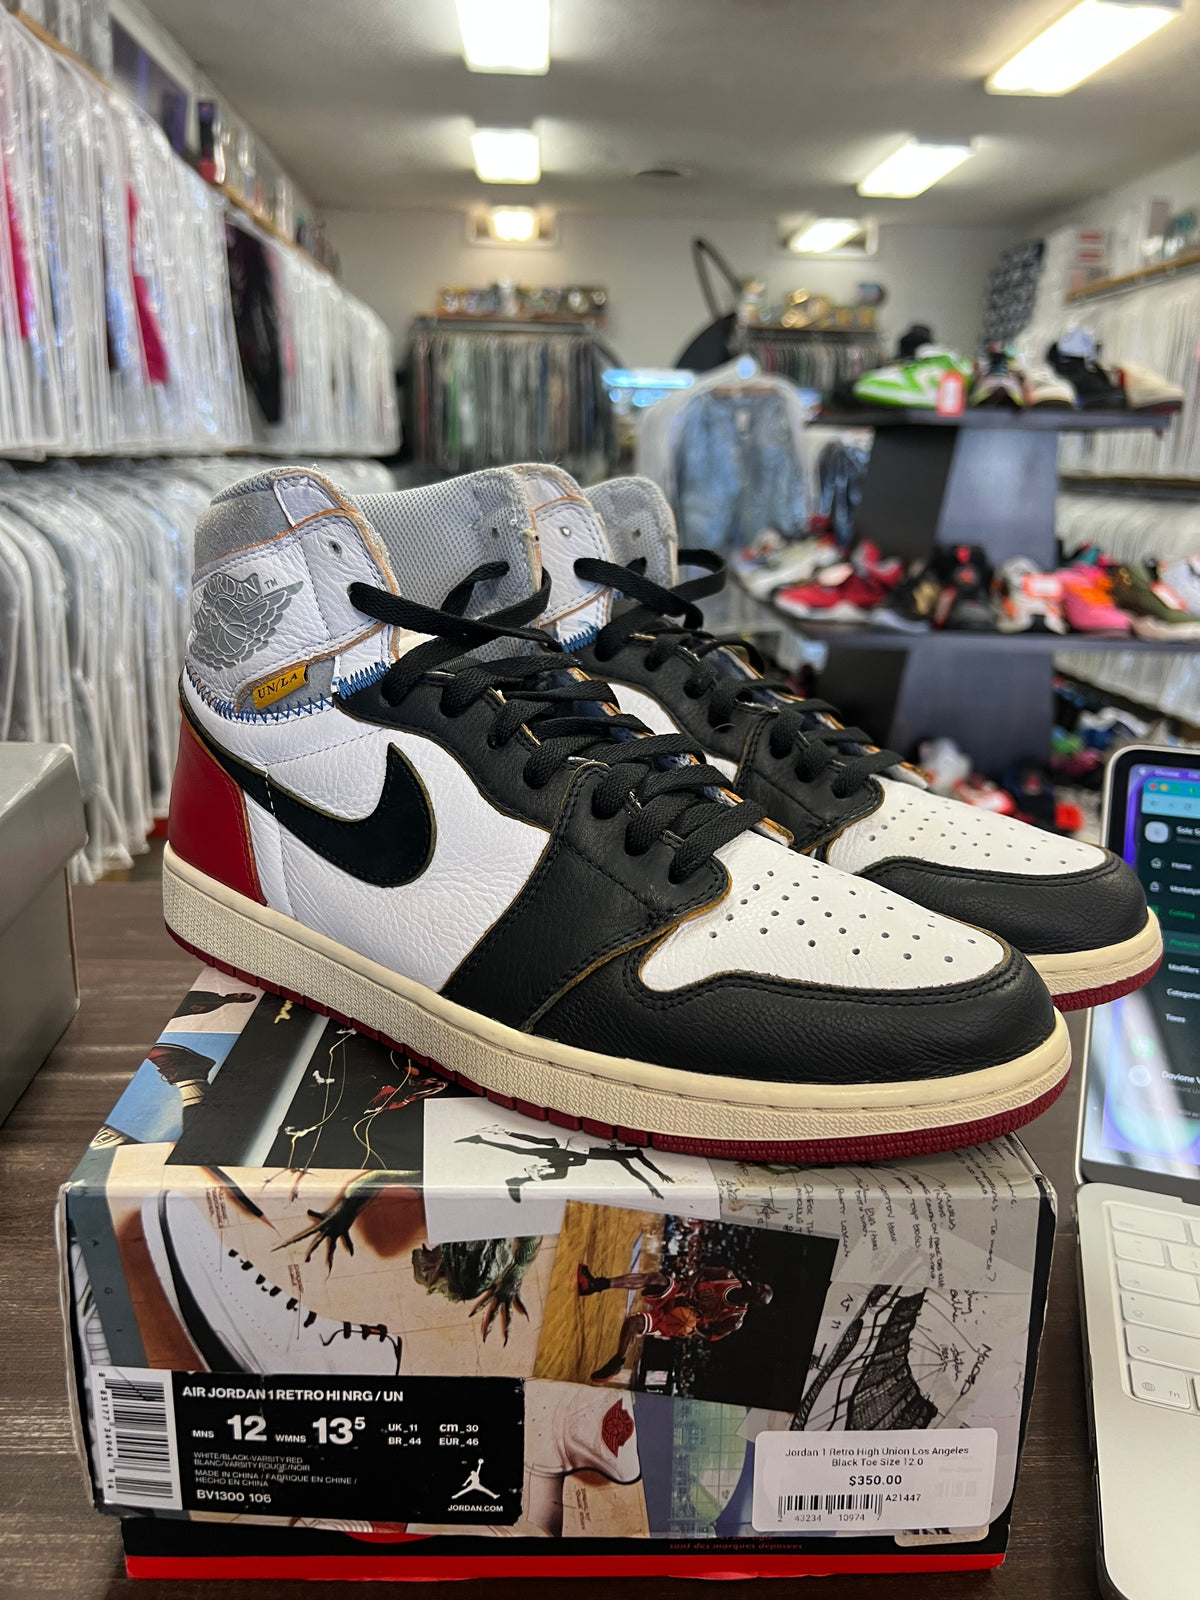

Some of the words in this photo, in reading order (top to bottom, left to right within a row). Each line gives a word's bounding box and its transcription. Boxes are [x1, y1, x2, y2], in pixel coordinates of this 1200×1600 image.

[257, 672, 298, 699] UN/LA
[182, 1386, 206, 1397] AIR
[208, 1387, 265, 1400] JORDAN
[268, 1390, 274, 1400] 1
[276, 1389, 324, 1401] RETRO
[327, 1390, 340, 1401] HI
[342, 1390, 373, 1401] NRG
[375, 1391, 381, 1402] /
[383, 1391, 403, 1402] UN
[192, 1430, 215, 1438] MNS
[227, 1414, 267, 1441] 12
[275, 1434, 306, 1443] WMNS
[785, 1448, 819, 1457] Jordan
[829, 1447, 854, 1456] Retro
[856, 1447, 880, 1458] High
[881, 1447, 910, 1456] Union
[912, 1447, 930, 1456] Los
[932, 1446, 969, 1457] Angeles
[194, 1458, 258, 1469] BLANC/VARSITY
[258, 1463, 311, 1471] ROUGE/NOIR
[286, 1456, 303, 1464] RED
[832, 1458, 858, 1467] Black
[860, 1458, 878, 1466] Toe
[880, 1458, 900, 1466] Size
[903, 1458, 924, 1466] 12.0
[195, 1469, 219, 1477] MADE
[232, 1471, 259, 1479] CHINA
[265, 1473, 309, 1482] FABRIQUE
[311, 1475, 324, 1483] EN
[325, 1476, 352, 1485] CHINE
[195, 1477, 226, 1485] HECHO
[228, 1478, 240, 1486] EN
[242, 1479, 269, 1487] CHINA
[849, 1475, 902, 1487] $350.00
[196, 1489, 245, 1501] BV1300
[248, 1493, 272, 1503] 106
[885, 1493, 922, 1502] A21447
[447, 1504, 504, 1512] JORDAN.COM
[838, 1513, 865, 1522] 10974
